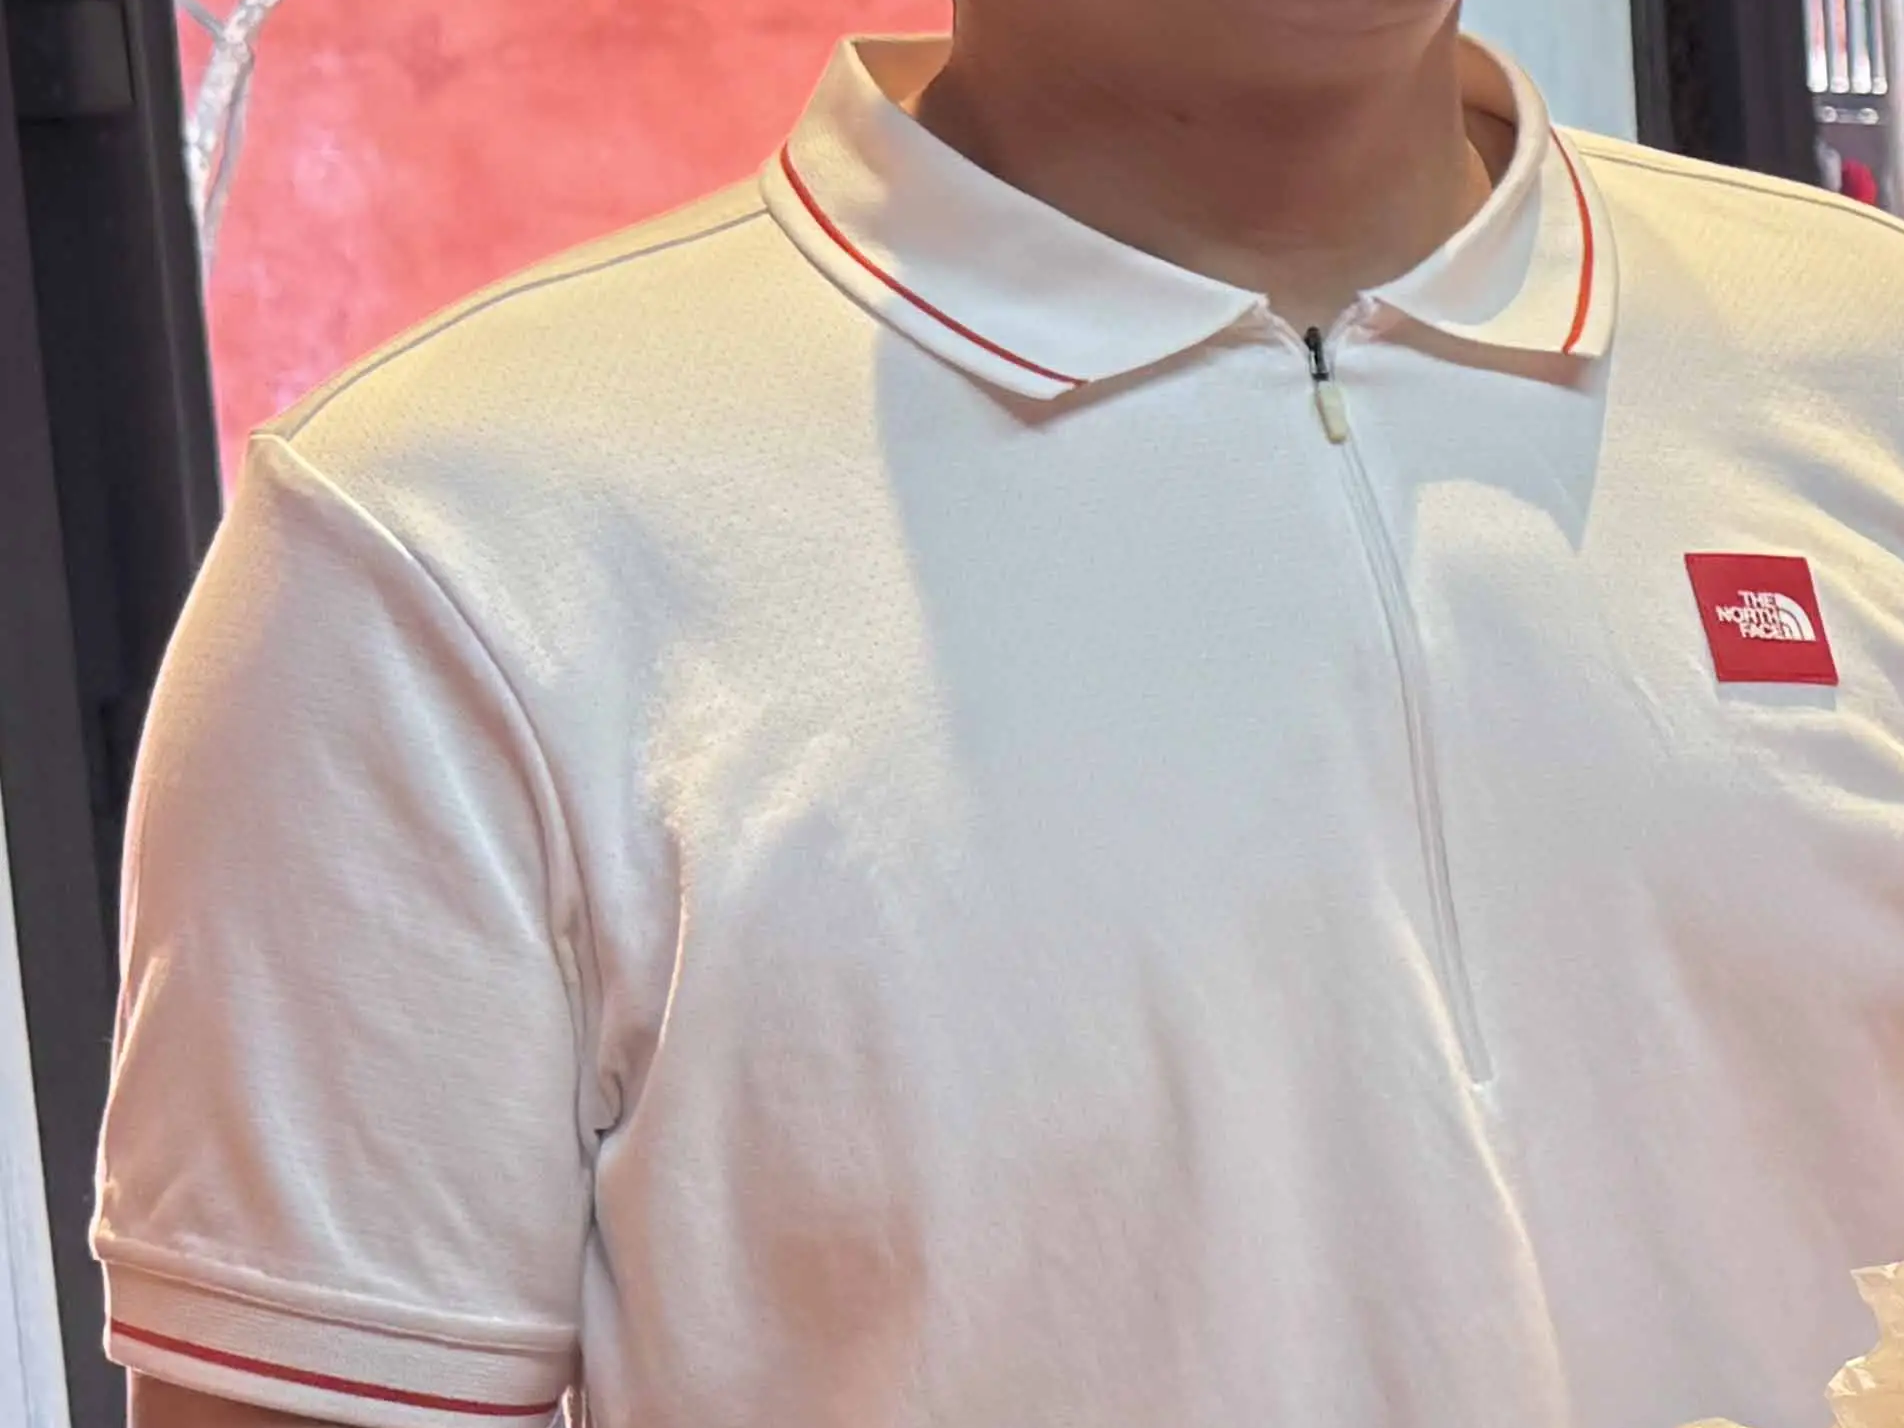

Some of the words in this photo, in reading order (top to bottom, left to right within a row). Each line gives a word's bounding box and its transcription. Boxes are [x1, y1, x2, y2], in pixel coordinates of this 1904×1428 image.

[1738, 590, 1777, 608] THE
[1716, 605, 1780, 625] NORTH
[1740, 623, 1784, 640] FACE
